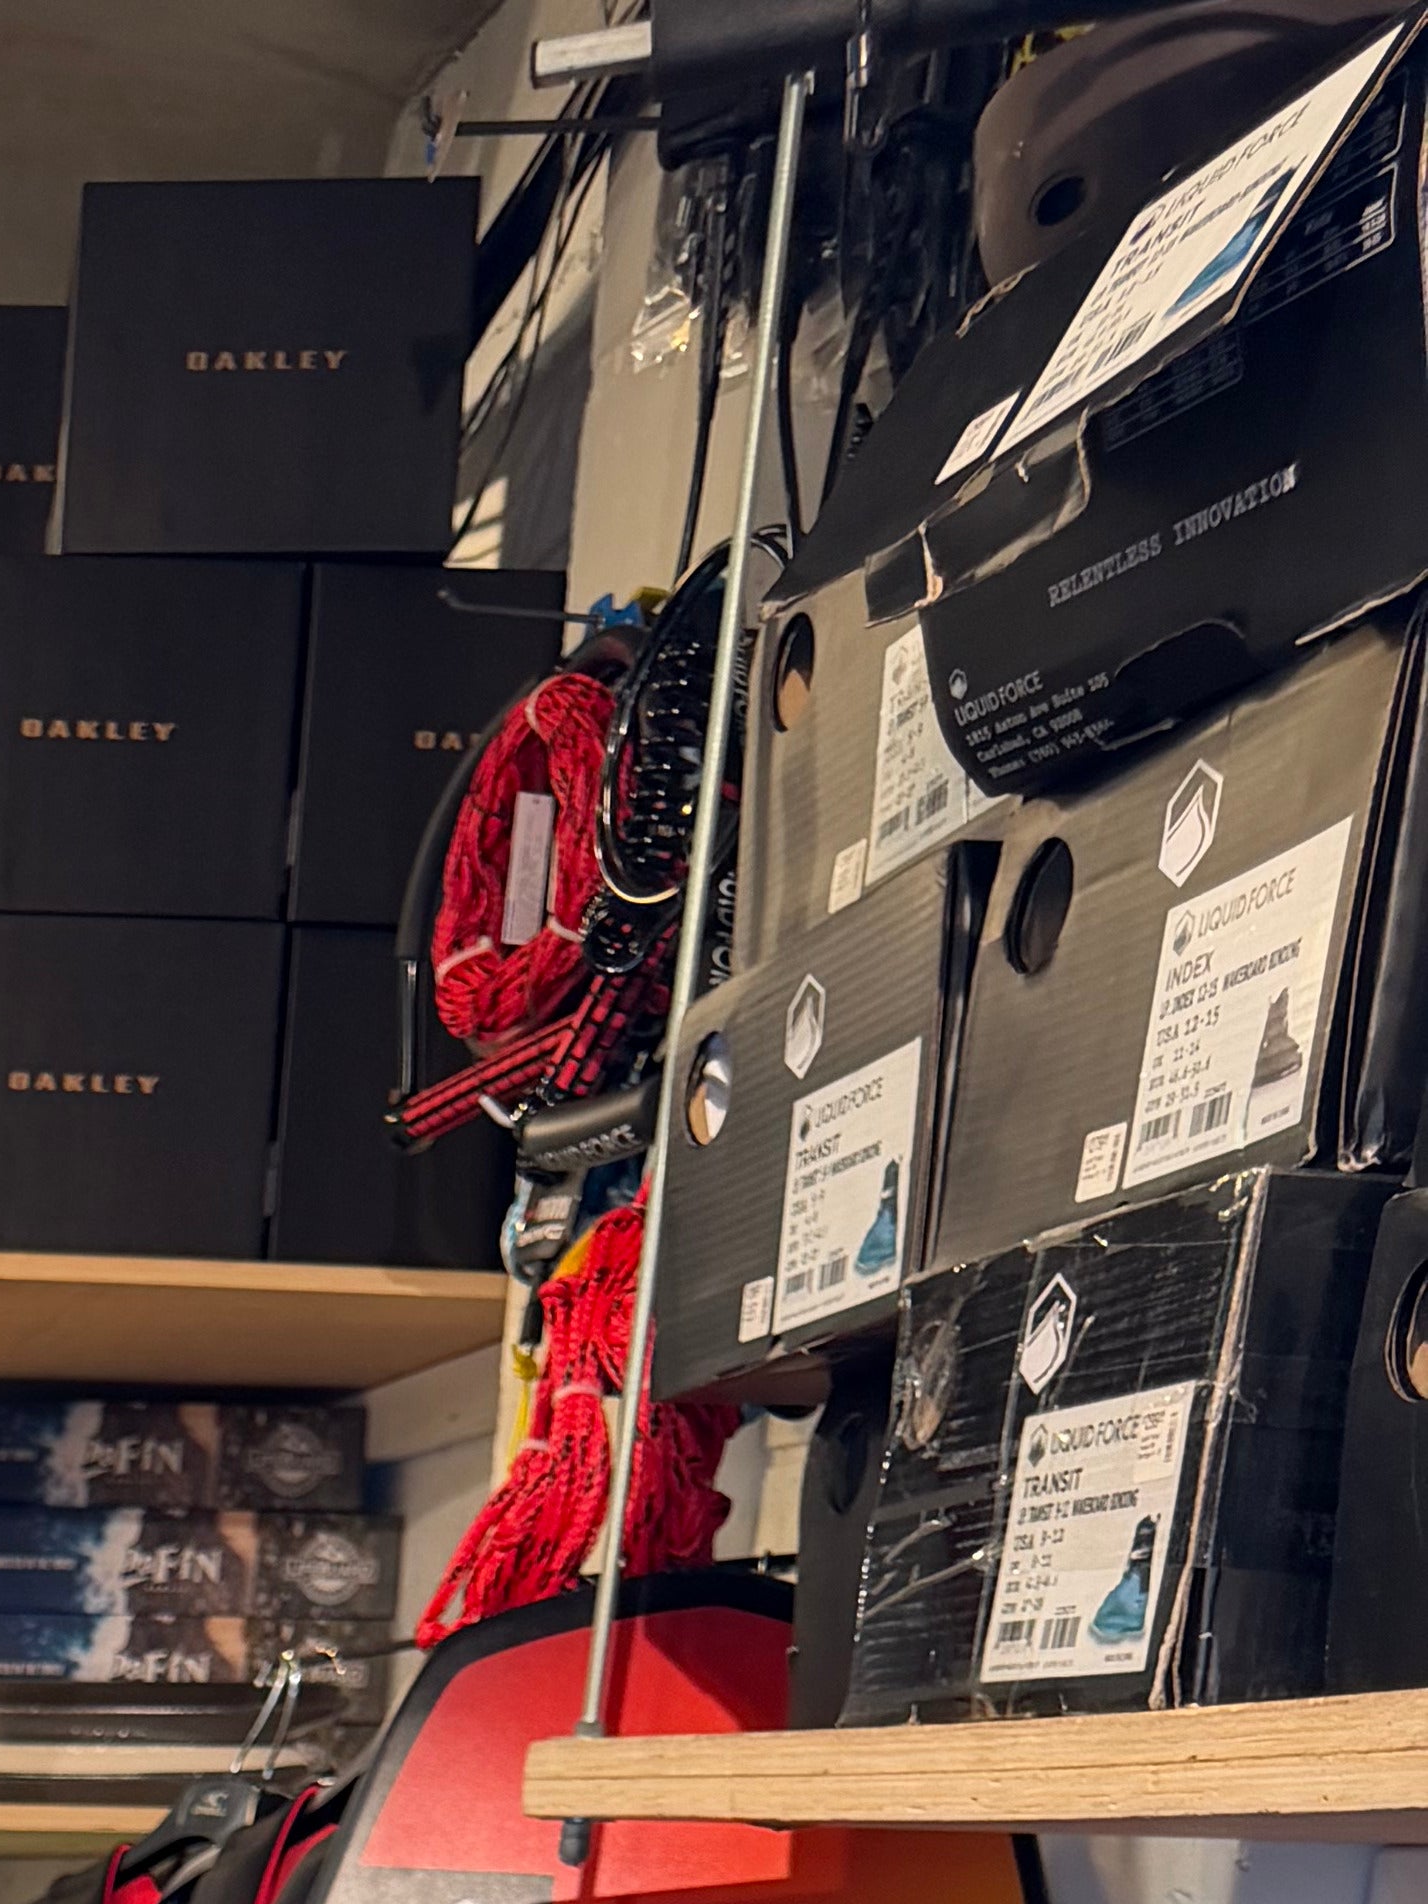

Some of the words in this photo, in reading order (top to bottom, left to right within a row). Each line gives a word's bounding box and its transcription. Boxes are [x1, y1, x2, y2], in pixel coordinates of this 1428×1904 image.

[187, 350, 348, 375] OAKLEY
[1048, 533, 1162, 608] RELENTLESS
[1173, 461, 1301, 545] INNOVATION
[20, 717, 179, 743] OAKLEY
[1164, 949, 1214, 992] INDEX
[1155, 1022, 1181, 1047] USA
[7, 1070, 162, 1094] OAKLEY
[1021, 1467, 1083, 1499] TRANSIT
